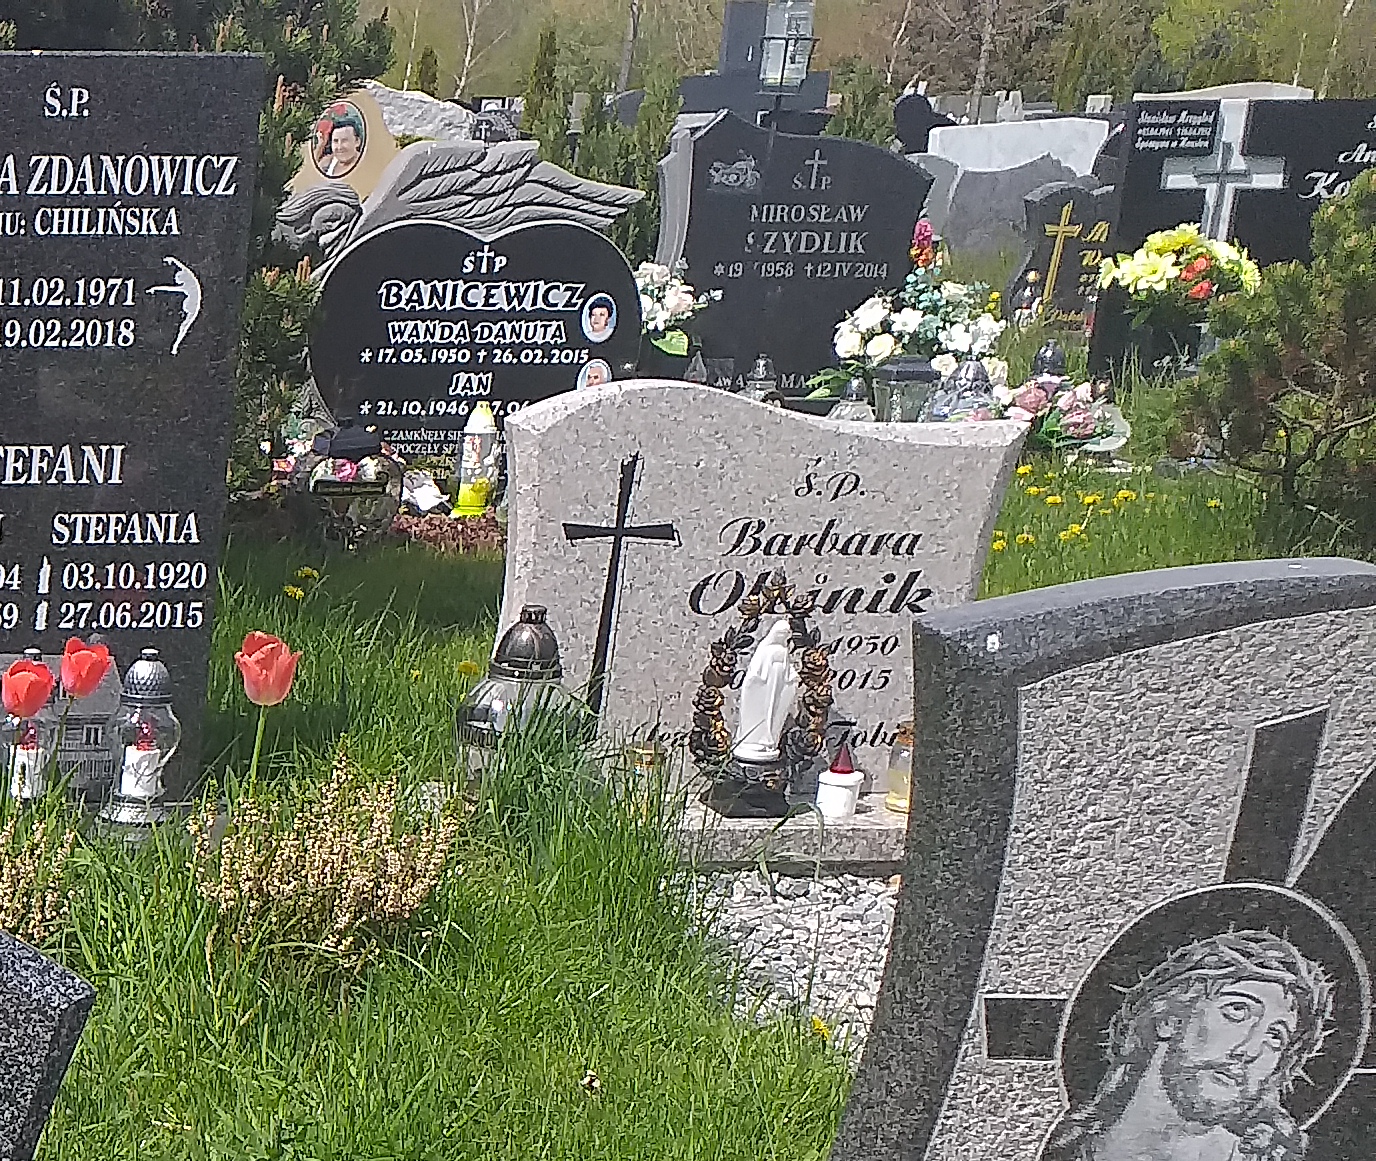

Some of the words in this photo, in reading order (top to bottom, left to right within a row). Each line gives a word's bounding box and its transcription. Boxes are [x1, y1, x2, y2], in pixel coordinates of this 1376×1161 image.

[43, 81, 90, 117] Ś.P.
[27, 154, 239, 196] ZDANOWICZ
[34, 201, 181, 236] CHILIŃSKA
[377, 278, 587, 312] BANICEWICZ
[388, 320, 470, 344] WANDA
[471, 320, 567, 344] DANUTA
[449, 372, 493, 396] JAN
[52, 513, 200, 545] STEFANIA
[718, 517, 923, 557] Barbara
[61, 562, 207, 590] 03.10.1920
[688, 569, 935, 616] Olnik
[58, 602, 204, 629] 27.06.2015
